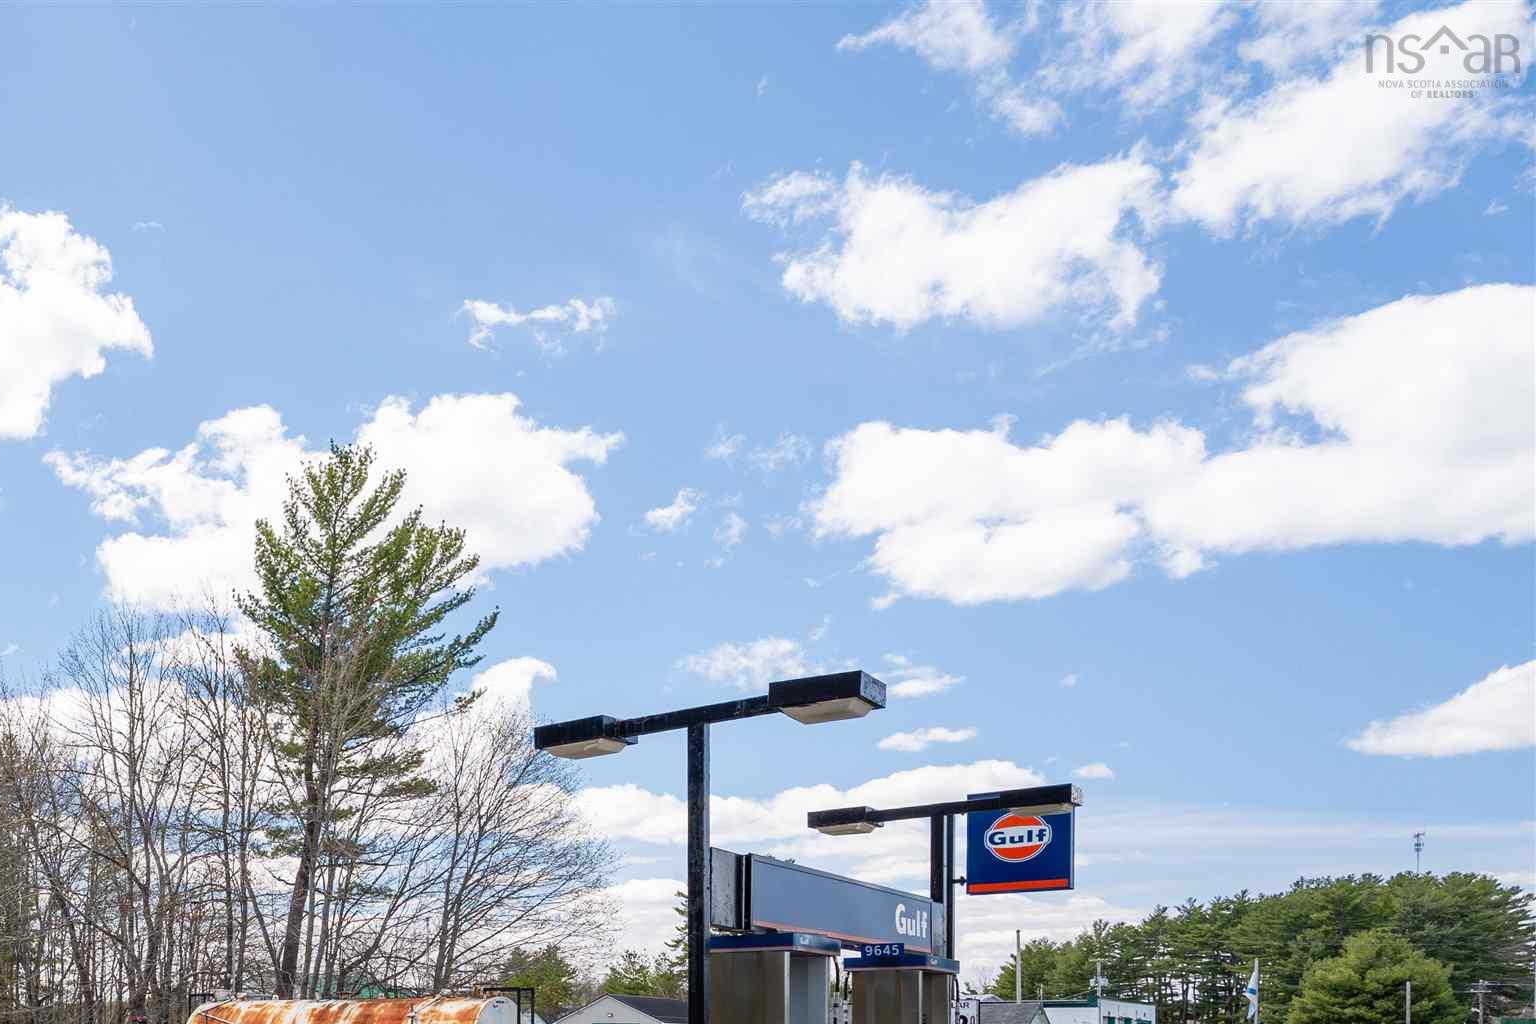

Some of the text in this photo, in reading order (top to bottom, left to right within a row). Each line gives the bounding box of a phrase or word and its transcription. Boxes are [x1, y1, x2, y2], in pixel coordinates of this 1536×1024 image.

[988, 828, 1047, 846] Gulf
[895, 903, 928, 938] Gulf
[865, 944, 900, 957] 9645
